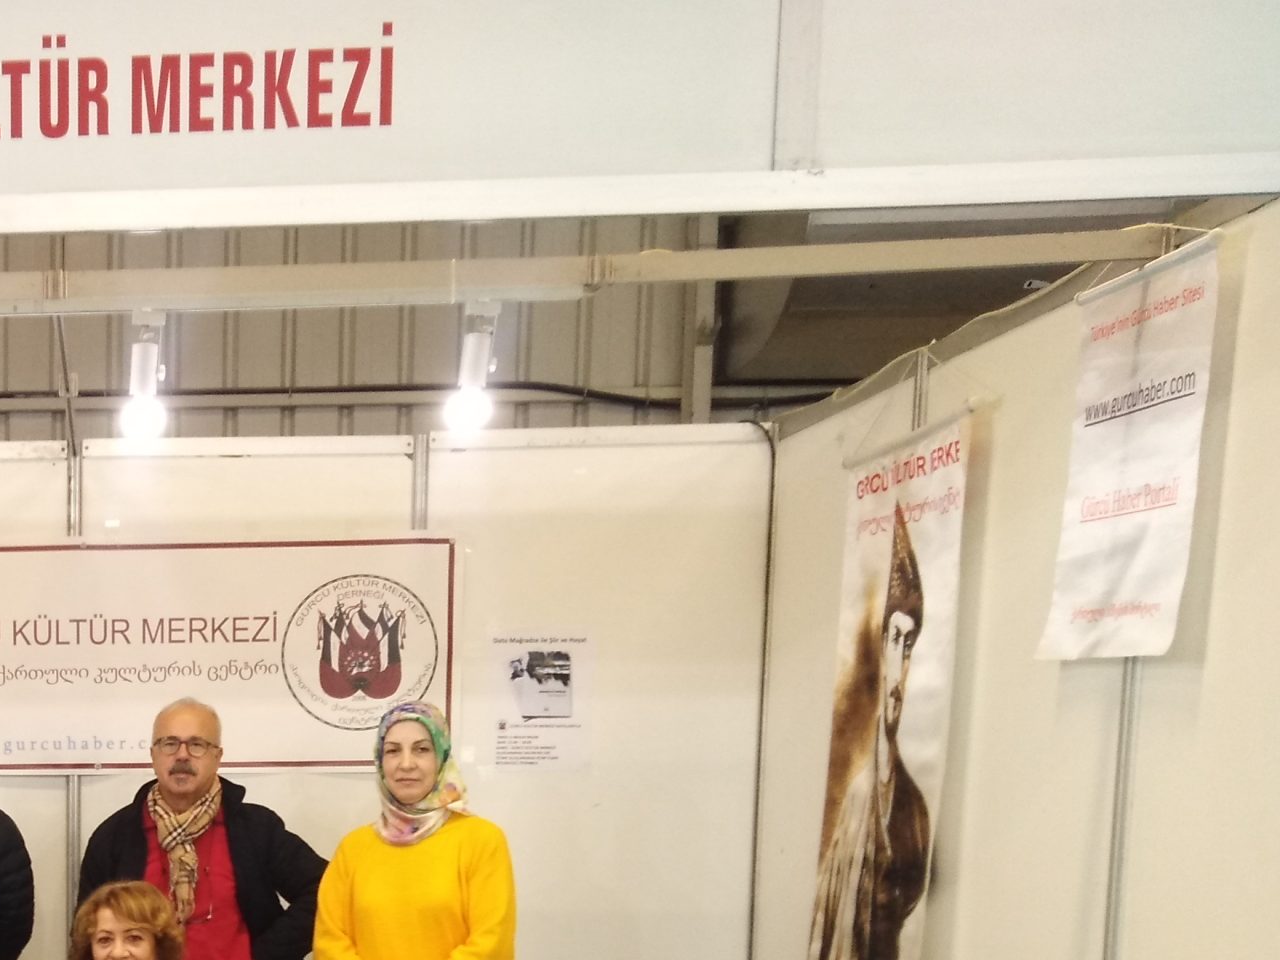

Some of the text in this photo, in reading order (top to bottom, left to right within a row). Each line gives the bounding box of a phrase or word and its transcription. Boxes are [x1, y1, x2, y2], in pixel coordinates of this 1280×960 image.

[130, 22, 394, 136] MERKEZİ
[12, 613, 131, 646] KÜLTÜR
[142, 610, 278, 645] MERKEZİ
[93, 660, 203, 684] კულტურის
[207, 659, 280, 682] ცენტრი
